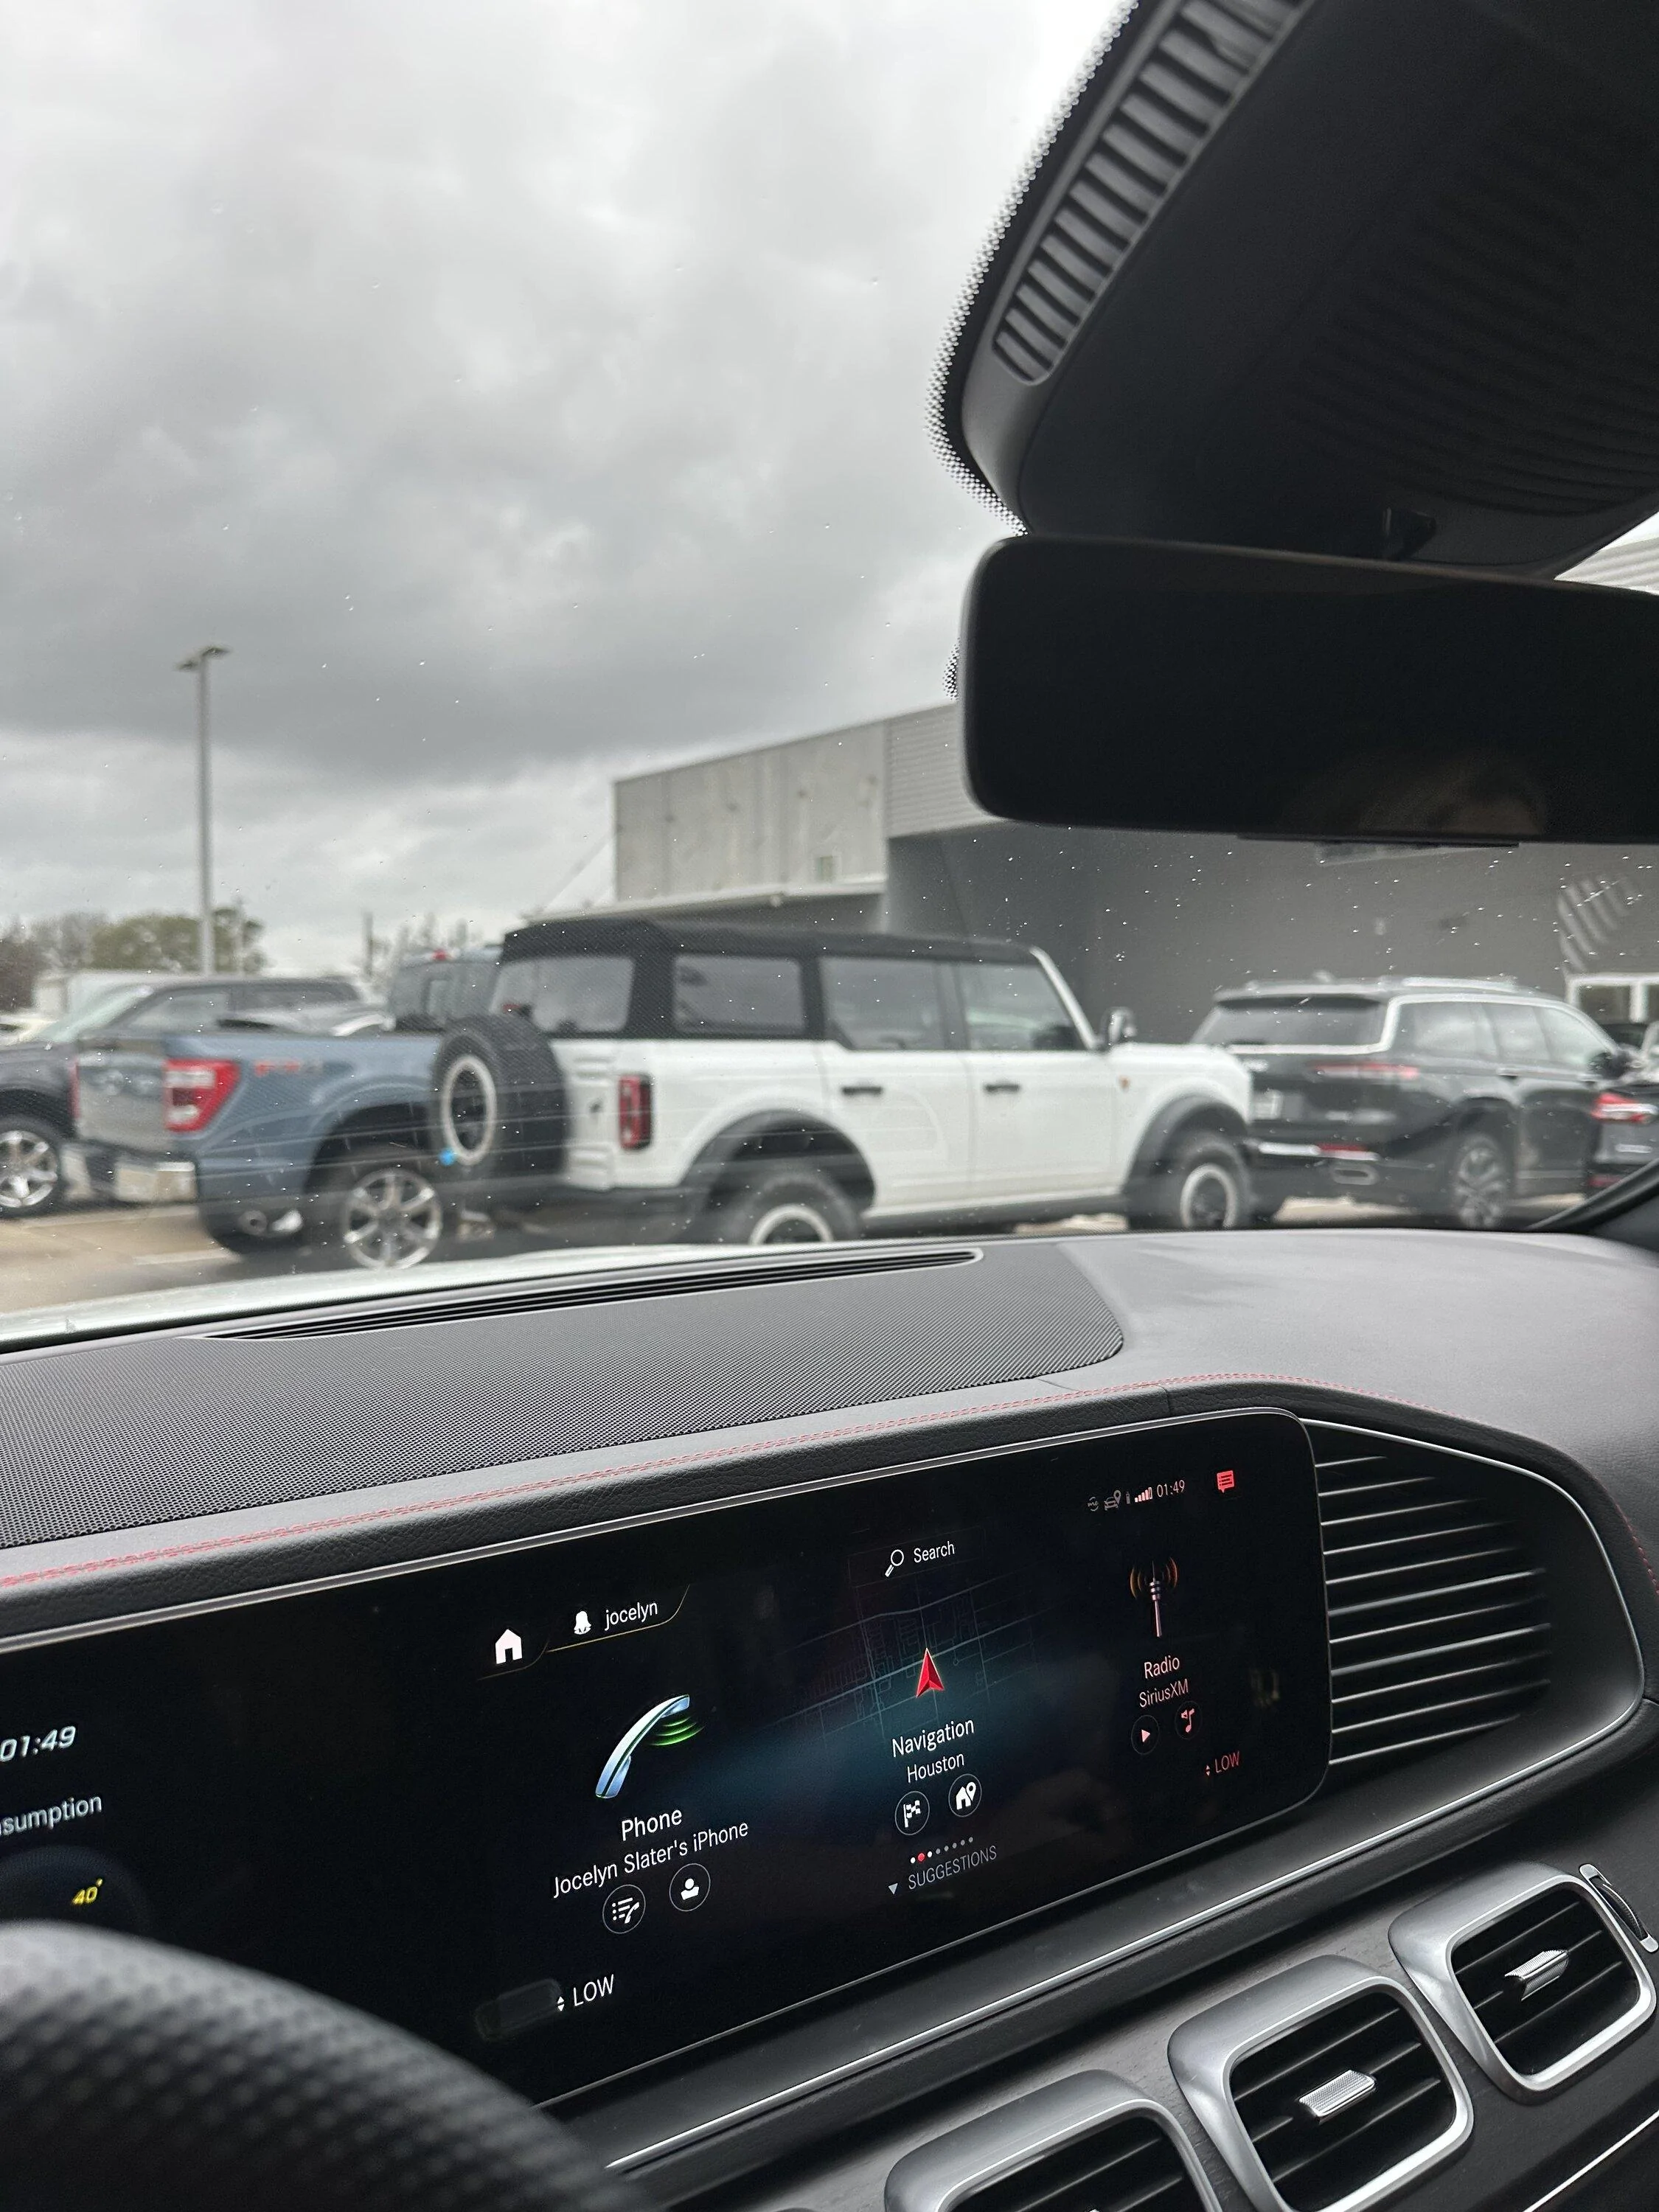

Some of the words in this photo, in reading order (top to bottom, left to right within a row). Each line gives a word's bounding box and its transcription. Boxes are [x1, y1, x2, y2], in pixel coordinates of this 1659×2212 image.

[1156, 1479, 1185, 1498] 01:49
[914, 1541, 955, 1563] Search
[604, 1601, 658, 1631] jocelyn
[1144, 1655, 1180, 1679] Radio
[1139, 1678, 1189, 1708] SiriusXM
[0, 1725, 76, 1762] 01:49
[892, 1719, 975, 1757] Navigation
[907, 1751, 965, 1783] Houston
[1214, 1751, 1239, 1774] LOW
[0, 1796, 102, 1836] sumption
[622, 1809, 683, 1841] Phone
[554, 1863, 618, 1899] Jocelyn
[624, 1840, 688, 1874] Slater's
[693, 1822, 748, 1851] iPhone
[908, 1845, 997, 1890] SUGGESTIONS
[573, 1974, 614, 2006] LOW
